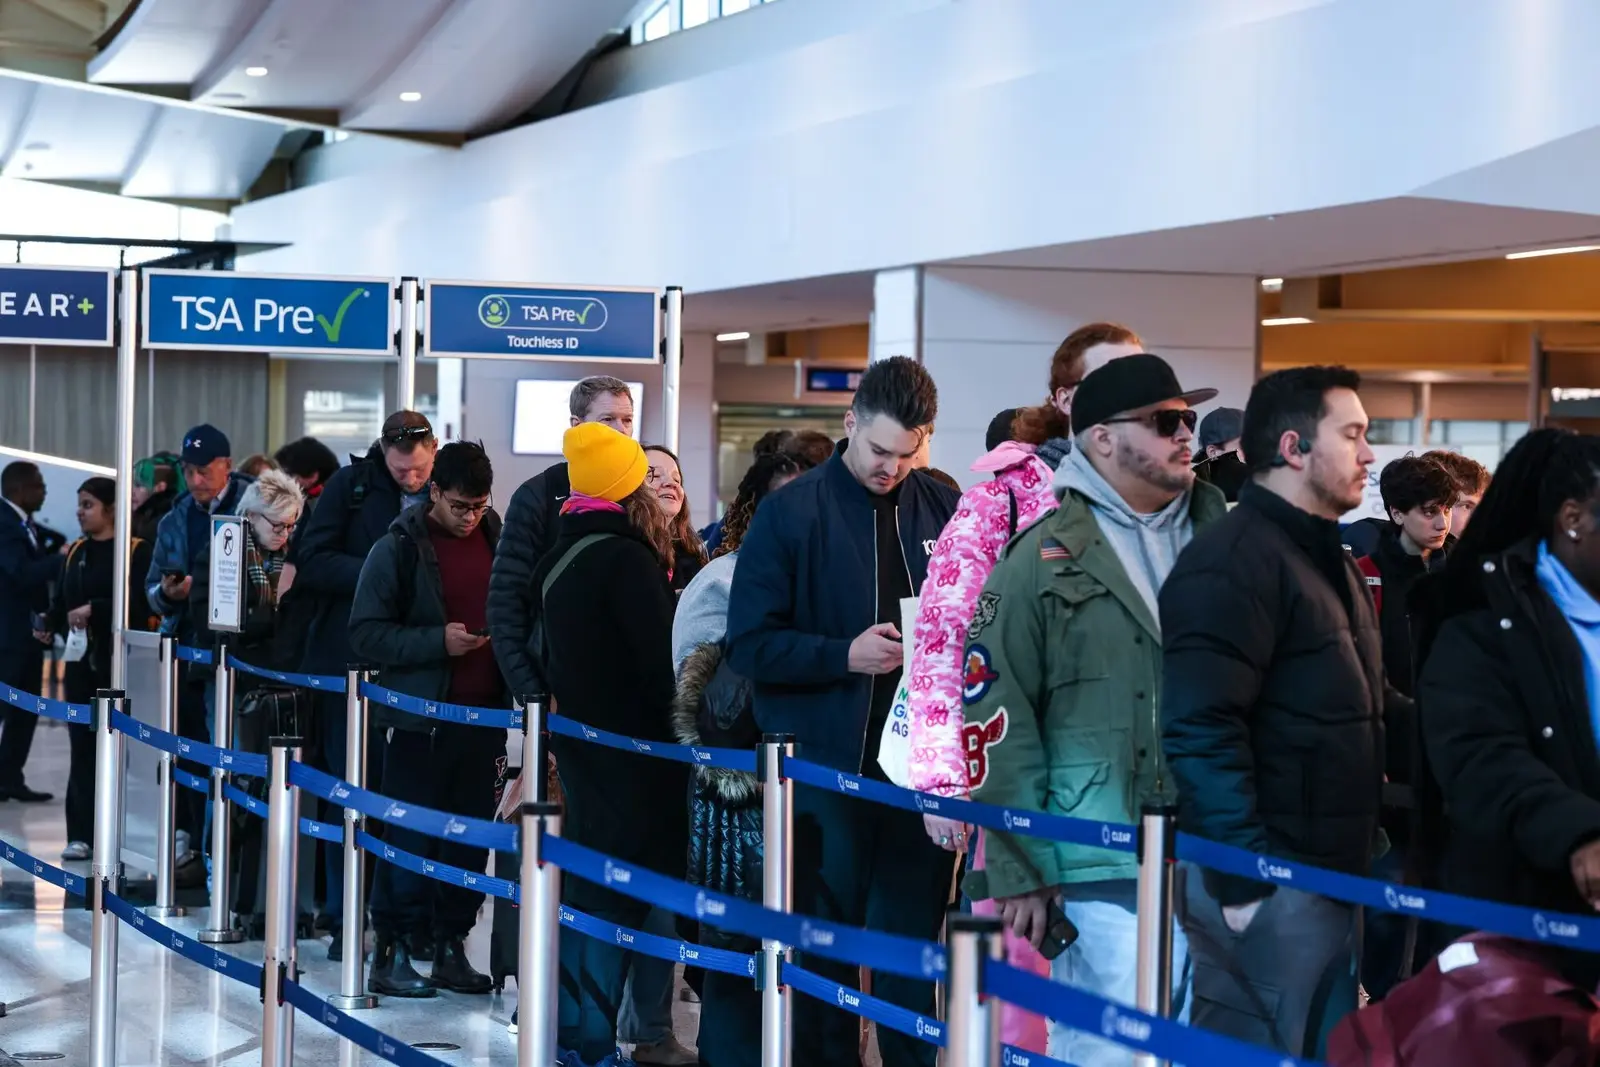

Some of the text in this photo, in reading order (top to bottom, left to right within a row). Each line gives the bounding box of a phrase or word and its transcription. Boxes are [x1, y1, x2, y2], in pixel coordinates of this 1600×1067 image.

[171, 296, 244, 332] TSA
[521, 305, 549, 321] TSA
[507, 335, 579, 349] Touchless ID
[1012, 816, 1031, 829] CLEAR
[1111, 831, 1132, 843] CLEAR
[563, 911, 575, 922] CLEAR
[622, 933, 634, 943] CLEAR
[685, 950, 699, 960] CLEAR
[845, 994, 860, 1008] CLEAR
[924, 1023, 941, 1038] CLEAR
[1011, 1054, 1030, 1067] CLEAR
